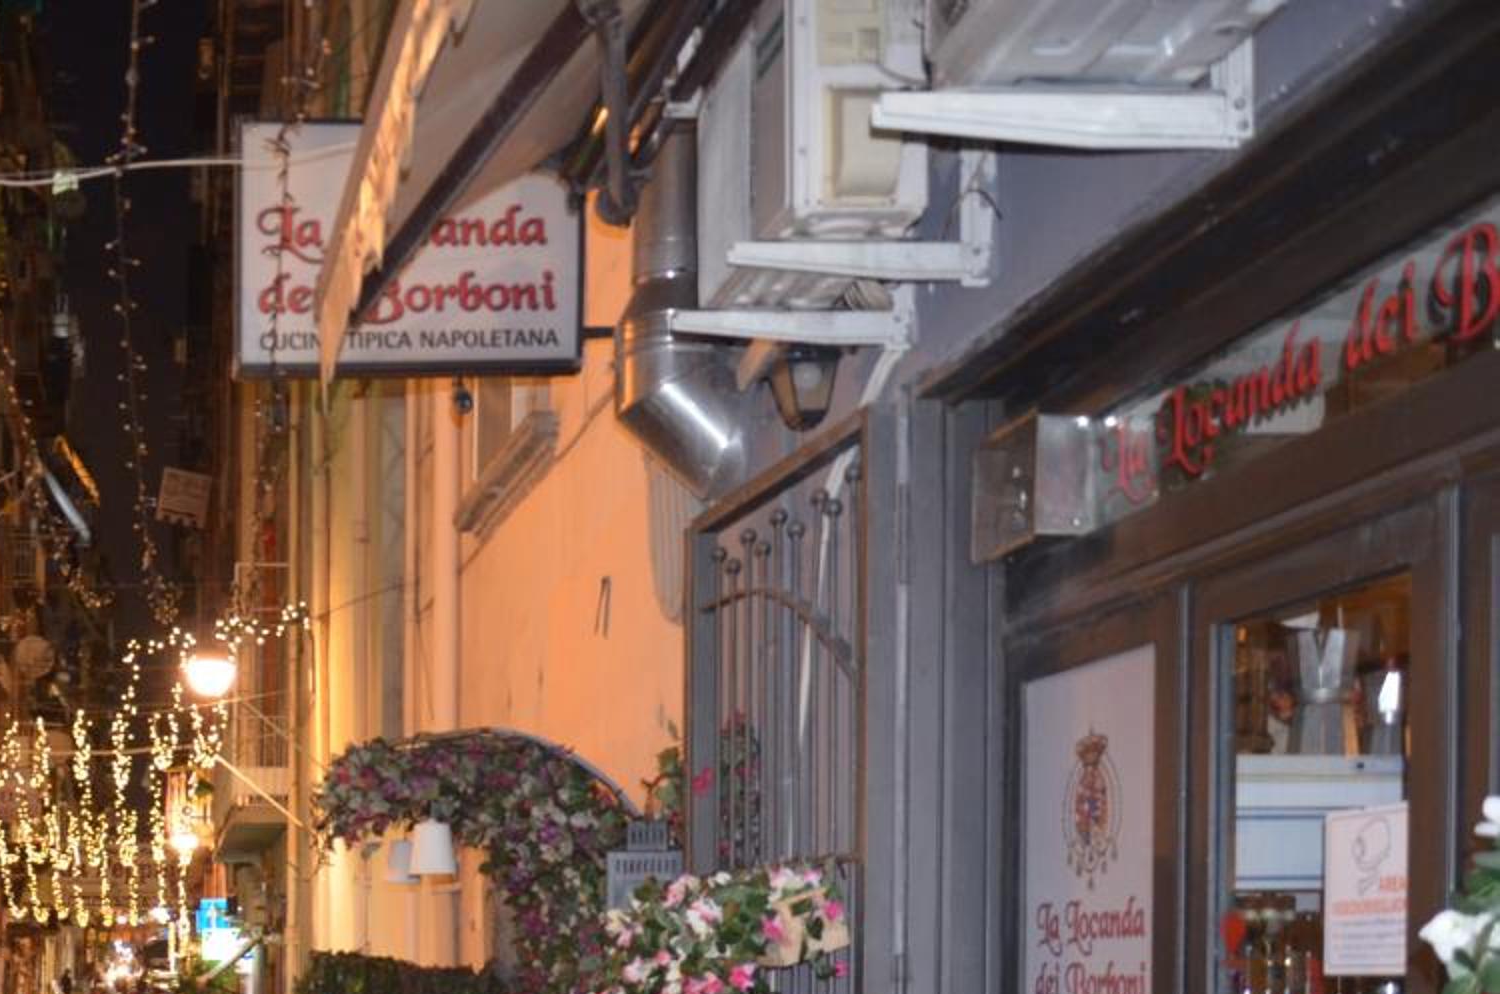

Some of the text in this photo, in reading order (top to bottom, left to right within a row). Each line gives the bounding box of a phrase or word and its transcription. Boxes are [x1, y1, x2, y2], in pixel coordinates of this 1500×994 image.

[257, 202, 324, 264] La
[257, 272, 316, 315] de
[259, 328, 560, 352] CUCIN TIPICA NAPOLETANA
[1098, 416, 1157, 505] La
[1346, 257, 1416, 372] dei
[1036, 896, 1146, 957] La Locanda
